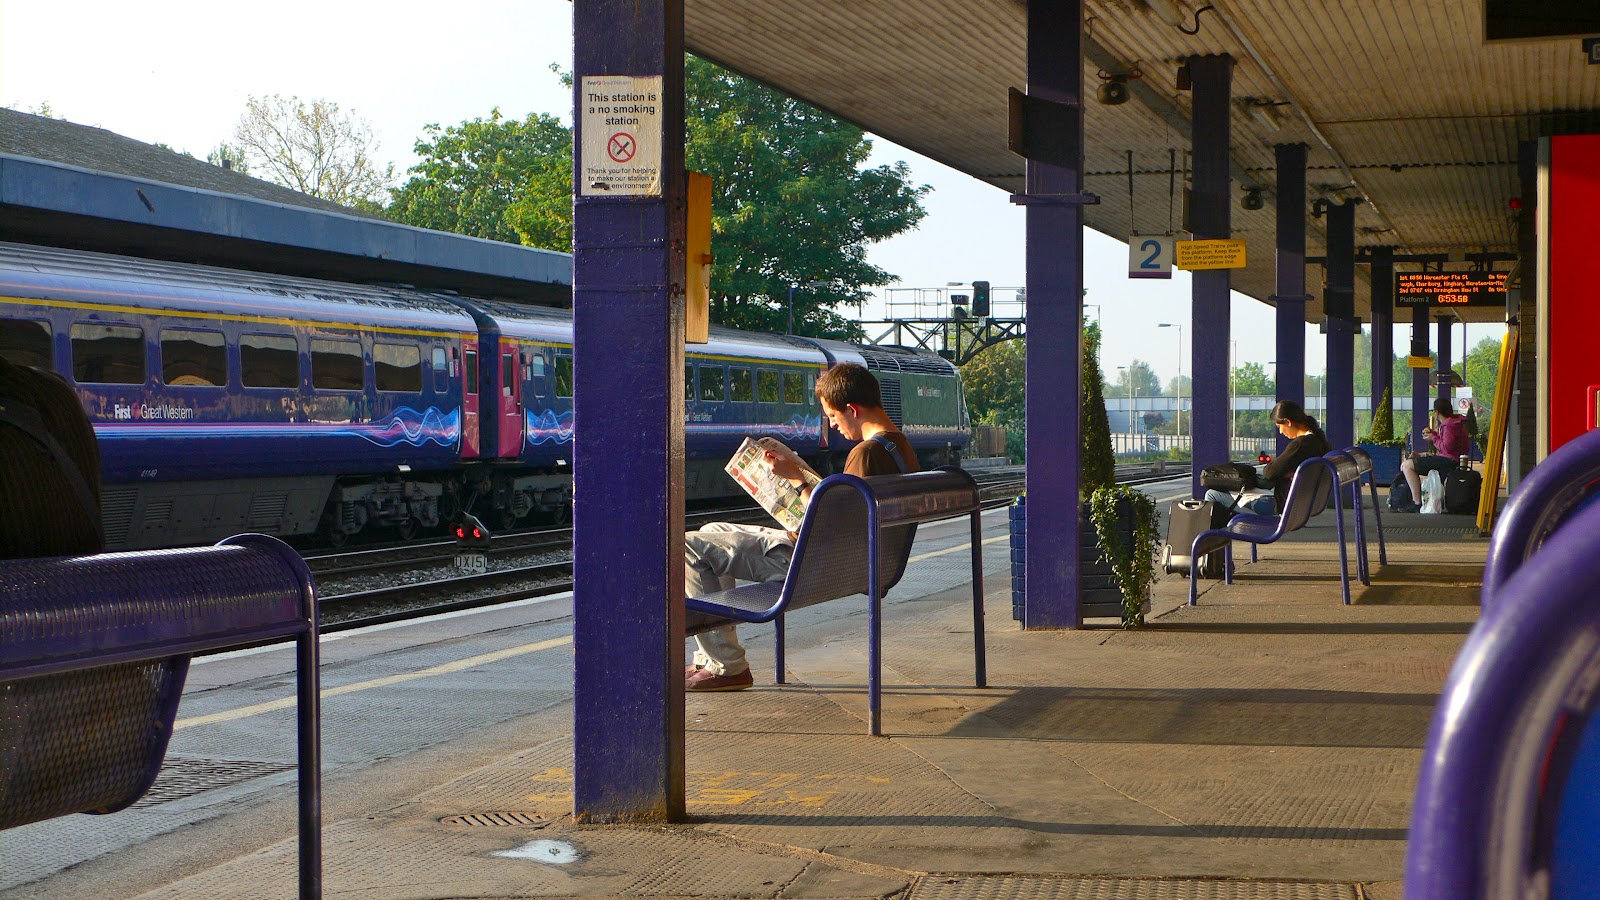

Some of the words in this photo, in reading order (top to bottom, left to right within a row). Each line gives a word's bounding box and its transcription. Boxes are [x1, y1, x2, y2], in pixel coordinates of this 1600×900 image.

[588, 93, 609, 102] This
[612, 93, 645, 101] station
[648, 93, 656, 101] is
[613, 105, 655, 115] smoking
[605, 116, 639, 125] station
[1141, 239, 1162, 269] 2
[114, 403, 131, 419] First
[140, 403, 162, 419] Great
[162, 404, 193, 419] Western
